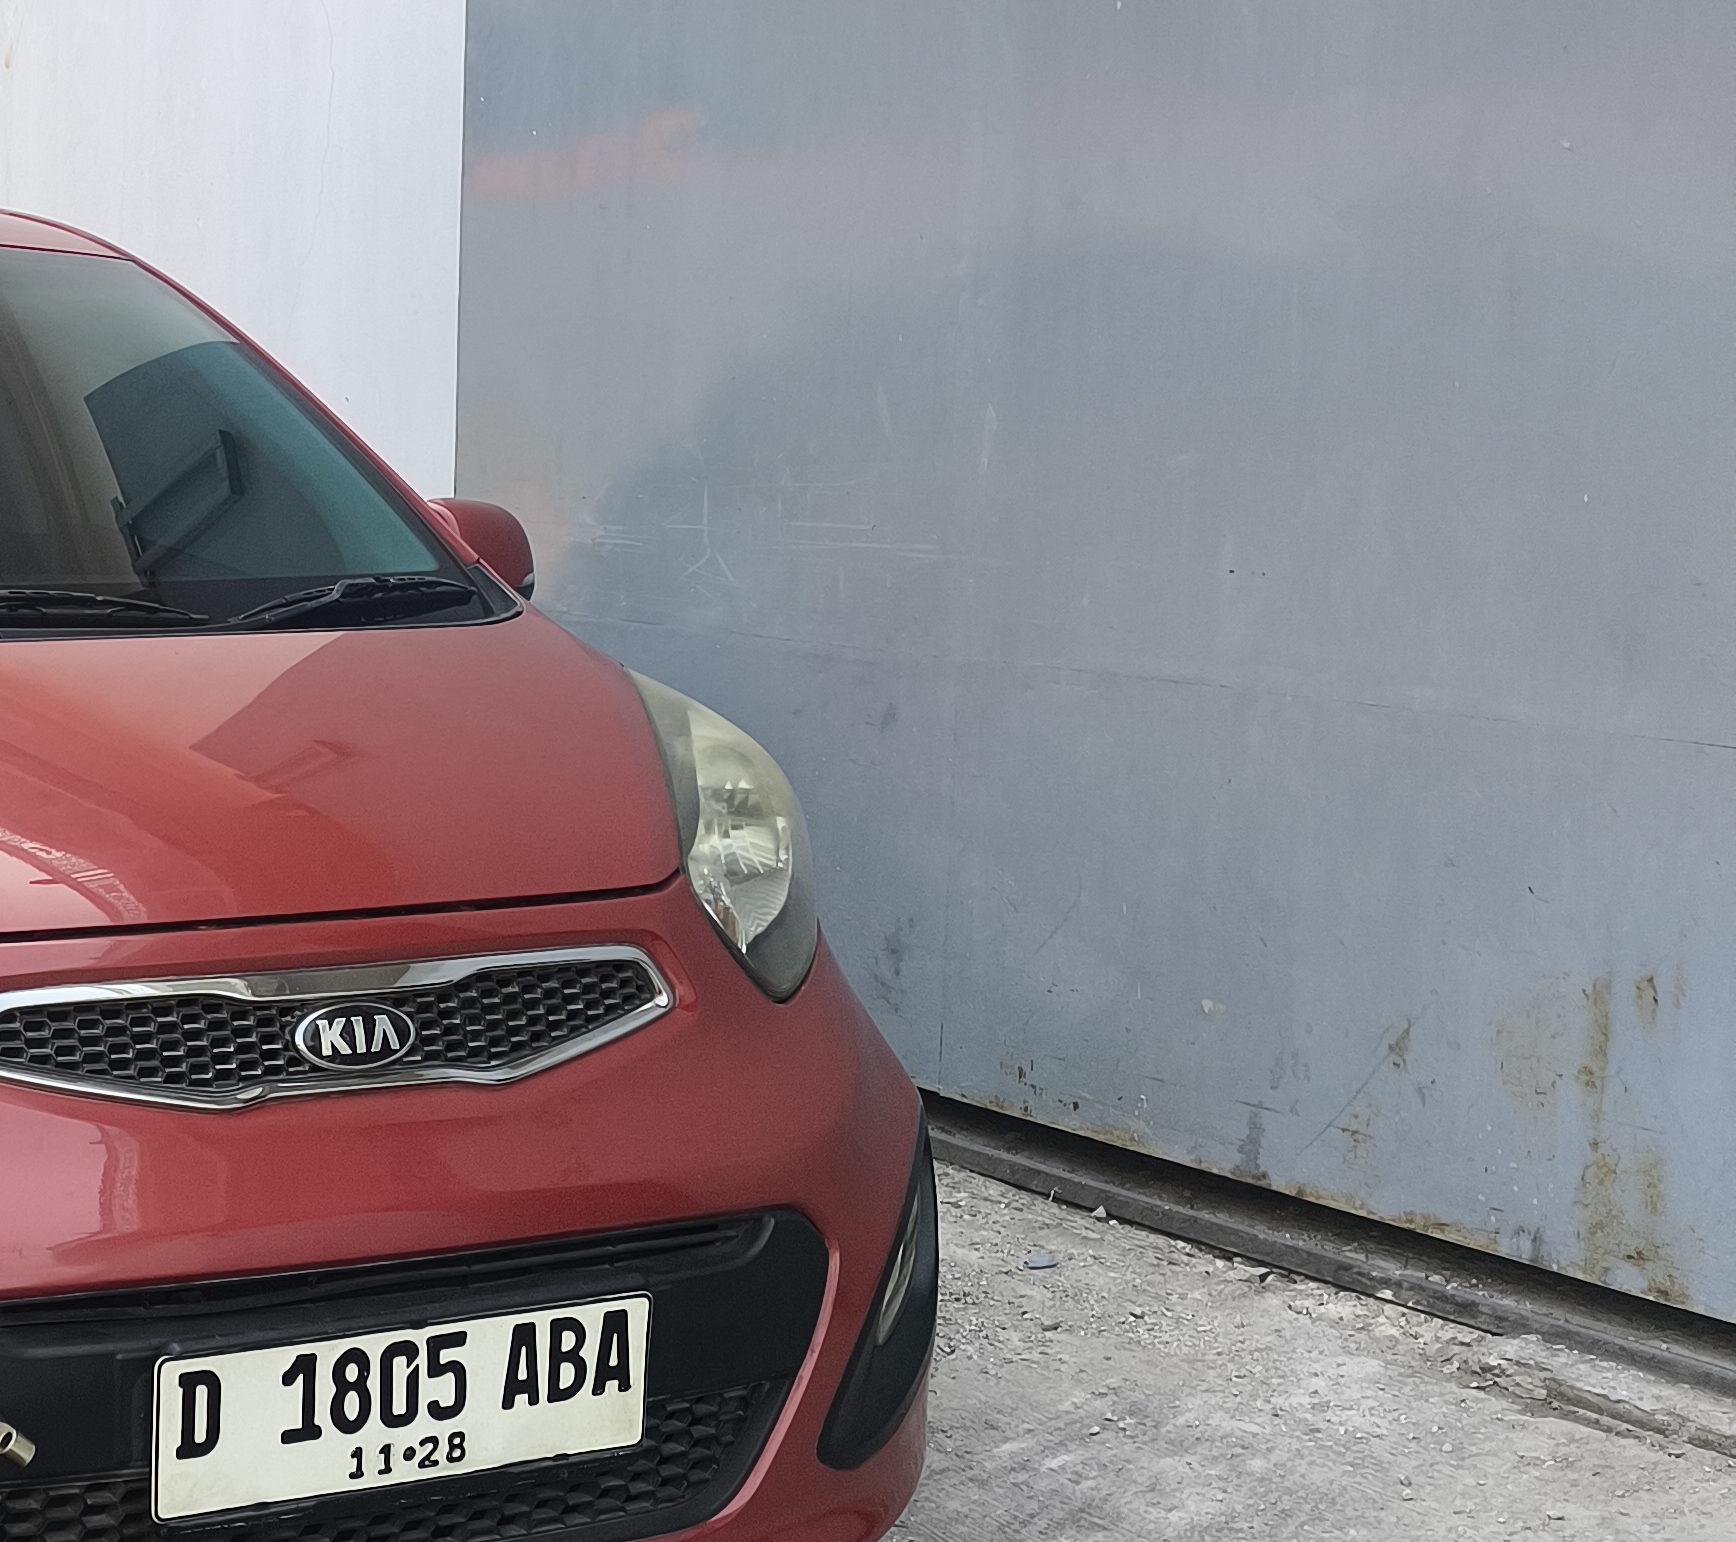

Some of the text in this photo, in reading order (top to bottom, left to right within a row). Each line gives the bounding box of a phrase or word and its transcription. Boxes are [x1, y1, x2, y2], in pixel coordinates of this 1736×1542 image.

[315, 1014, 401, 1057] KIA
[175, 1308, 632, 1460] D 1805 ABA
